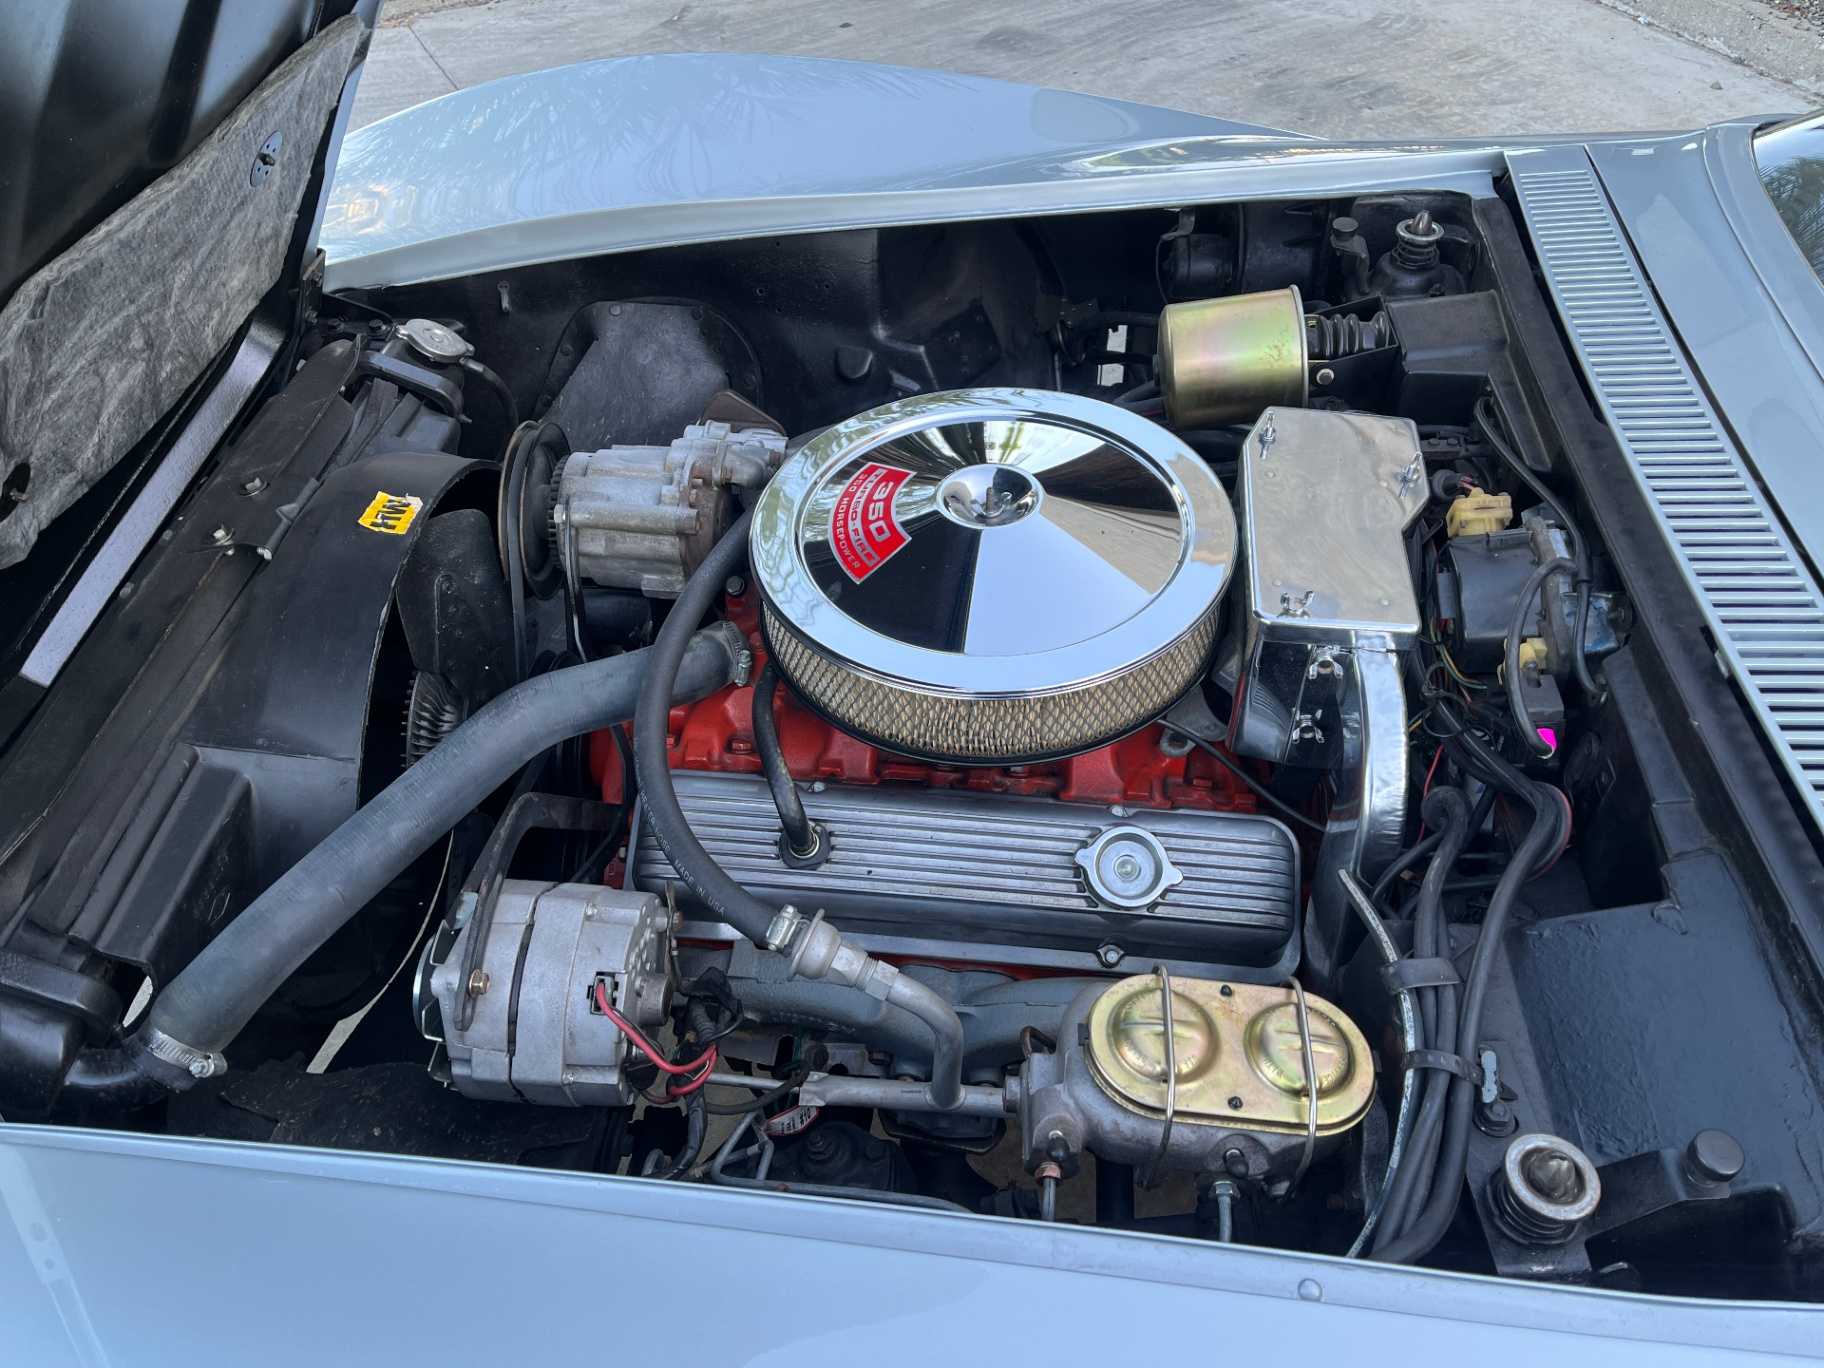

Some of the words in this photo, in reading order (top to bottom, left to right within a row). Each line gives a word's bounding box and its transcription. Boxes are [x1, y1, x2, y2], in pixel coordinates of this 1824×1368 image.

[836, 497, 861, 568] HORSEPOWER
[868, 481, 894, 543] 350
[673, 858, 695, 885] MADE
